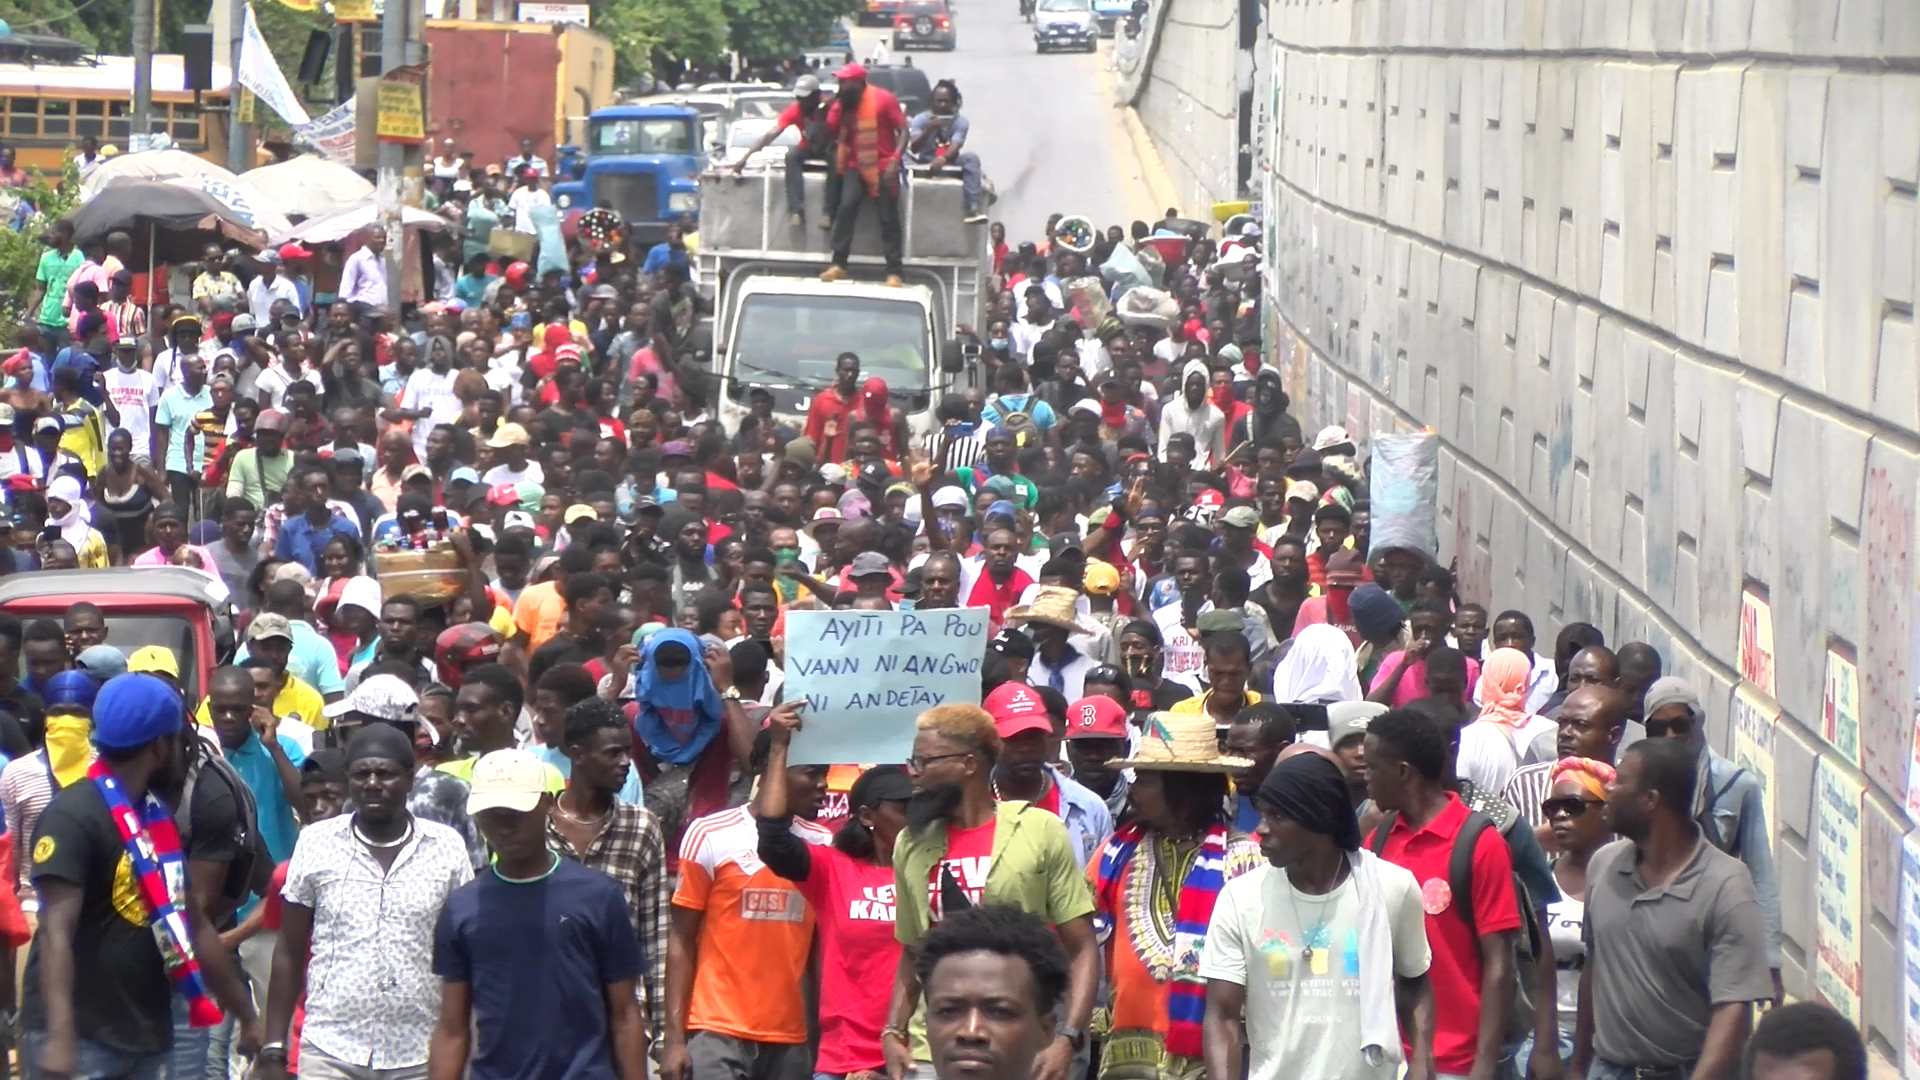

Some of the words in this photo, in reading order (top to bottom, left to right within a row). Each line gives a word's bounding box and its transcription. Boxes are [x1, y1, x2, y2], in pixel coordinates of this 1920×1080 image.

[819, 614, 883, 647] AYITI
[900, 614, 927, 637] PA
[943, 613, 982, 638] POU
[791, 656, 859, 677] VANN
[800, 693, 828, 714] NI
[1079, 704, 1097, 727] B
[863, 883, 896, 903] LE
